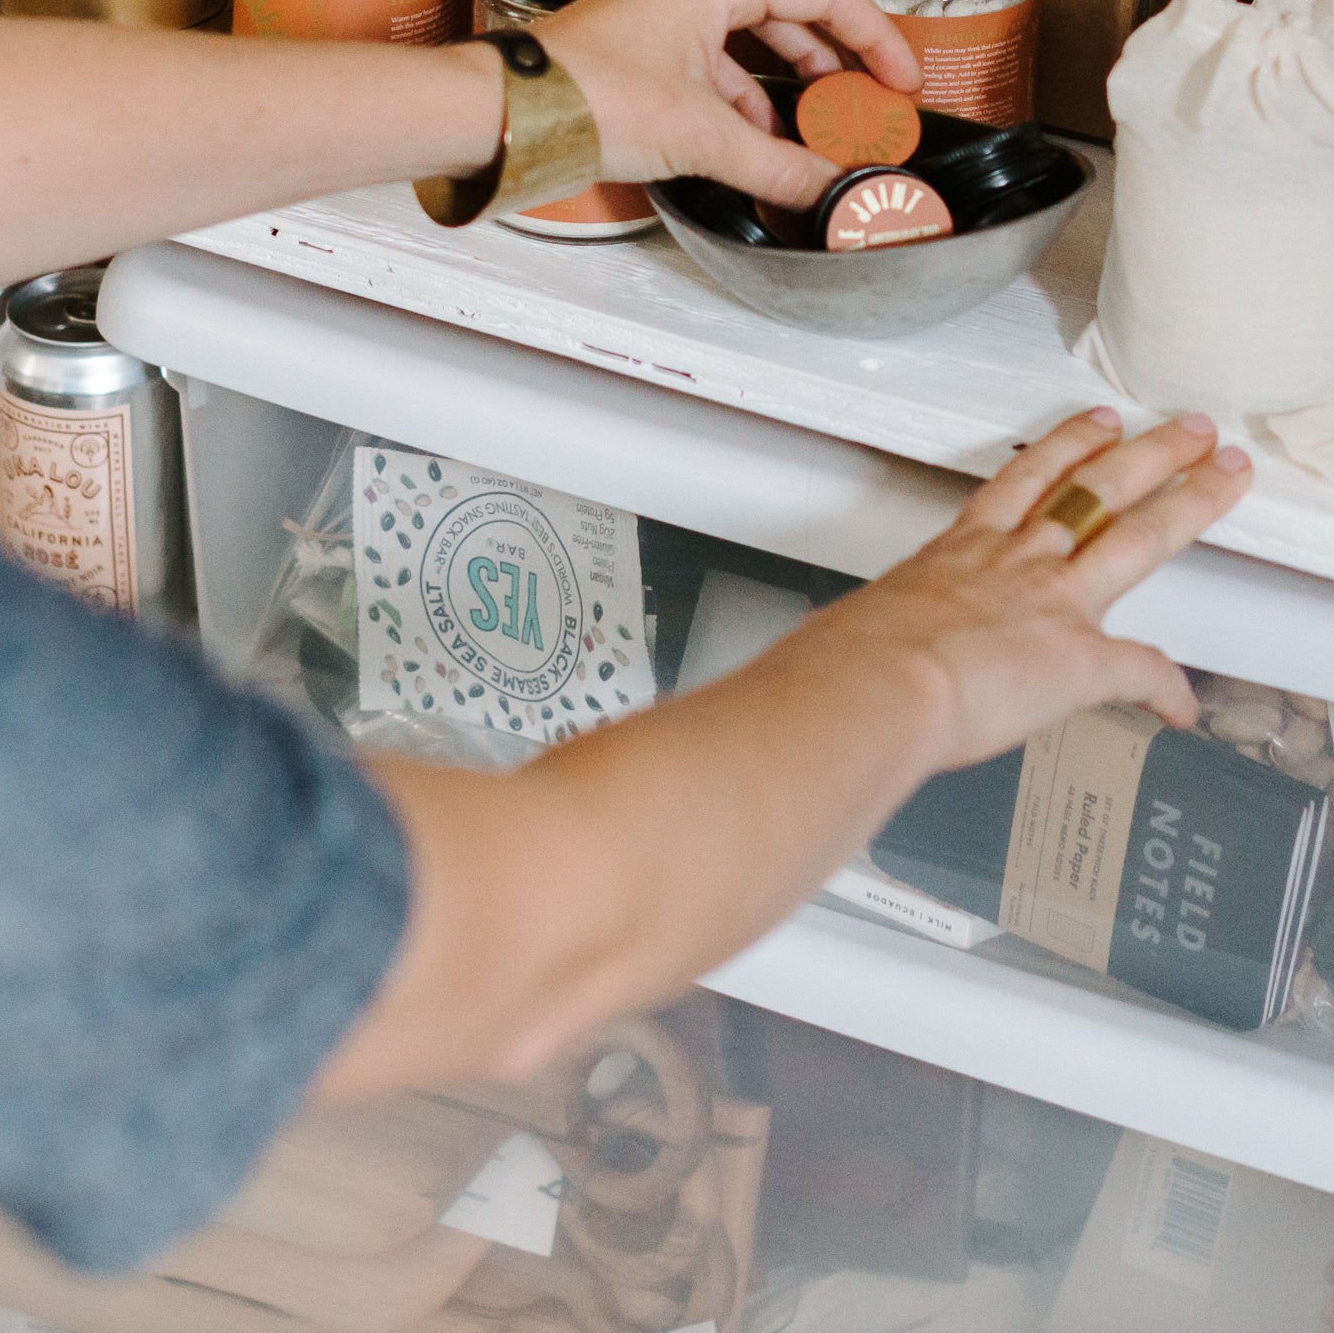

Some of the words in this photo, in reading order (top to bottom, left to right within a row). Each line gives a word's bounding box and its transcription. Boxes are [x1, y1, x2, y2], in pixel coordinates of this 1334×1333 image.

[849, 181, 924, 224] JOINT
[49, 461, 103, 500] LOU
[445, 504, 483, 539] SNACK
[485, 501, 530, 520] TASTING
[528, 514, 551, 545] BEST
[589, 570, 615, 588] Vegan
[424, 580, 455, 634] SALT
[467, 556, 544, 652] YES
[450, 632, 488, 670] SEA
[545, 613, 577, 683] BLACK
[491, 664, 550, 696] SESAME
[1078, 791, 1096, 841] Ruled
[1068, 842, 1087, 891] Paper
[1130, 798, 1183, 948] NOTES
[865, 891, 916, 917] ECUADOR
[1179, 834, 1223, 952] FIELD
[926, 916, 953, 932] MILK
